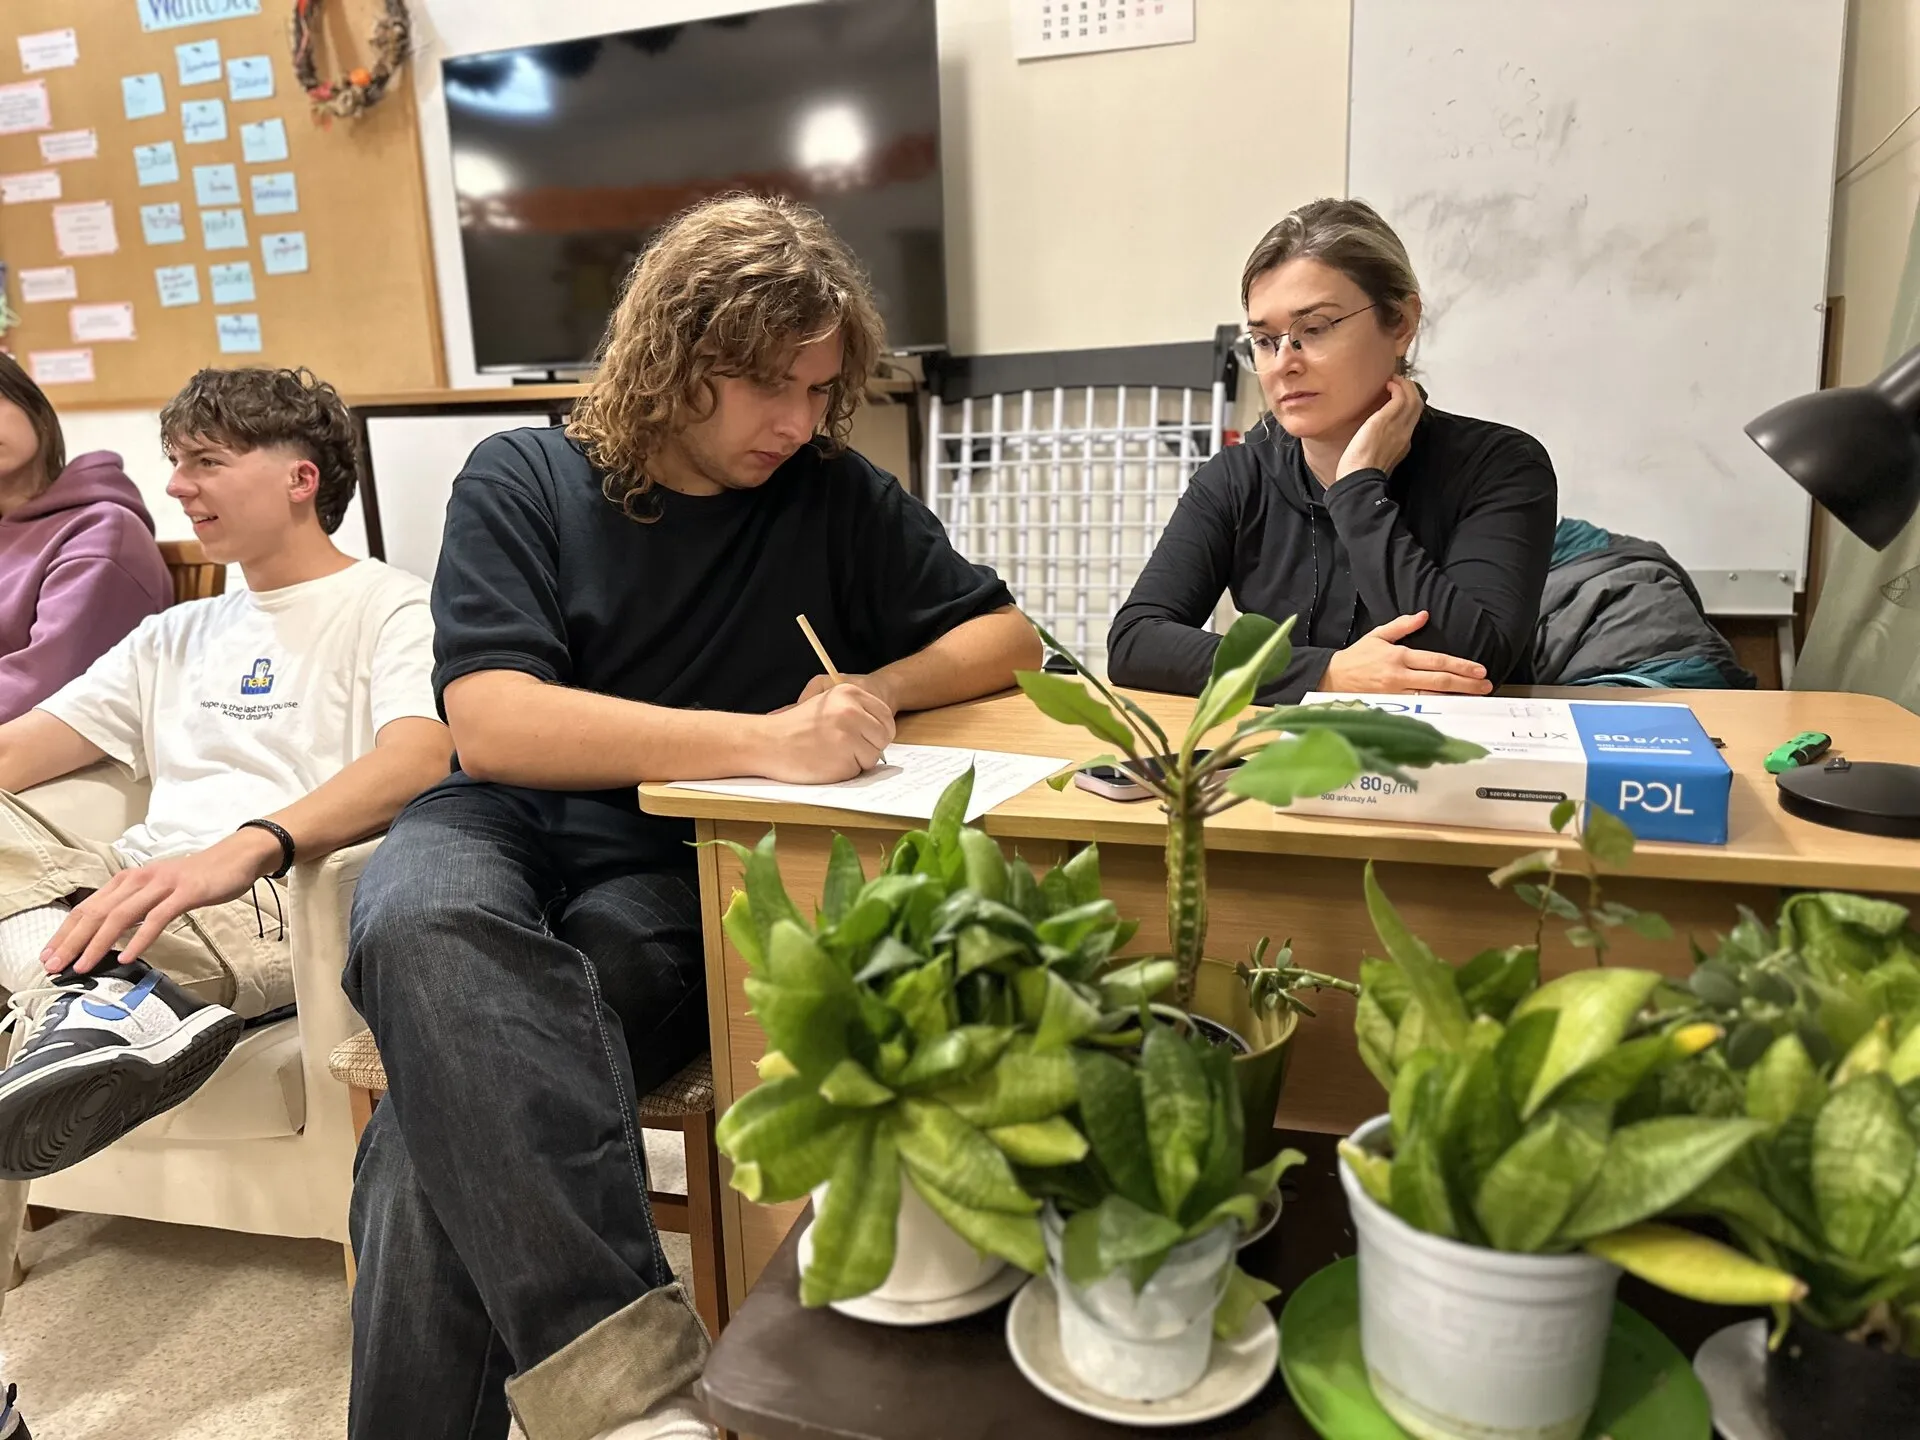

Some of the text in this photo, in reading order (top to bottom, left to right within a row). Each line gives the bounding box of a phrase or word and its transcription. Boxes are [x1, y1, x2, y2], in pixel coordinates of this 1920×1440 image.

[200, 700, 219, 709] Hope
[220, 701, 228, 709] is
[228, 703, 242, 712] the
[243, 704, 257, 713] last
[222, 710, 245, 720] Keep
[1511, 731, 1568, 740] LUX
[1321, 793, 1335, 801] 500
[1336, 794, 1366, 804] arkuszy
[1489, 790, 1562, 801] szerokie zastosowanie
[1619, 780, 1695, 815] POL
